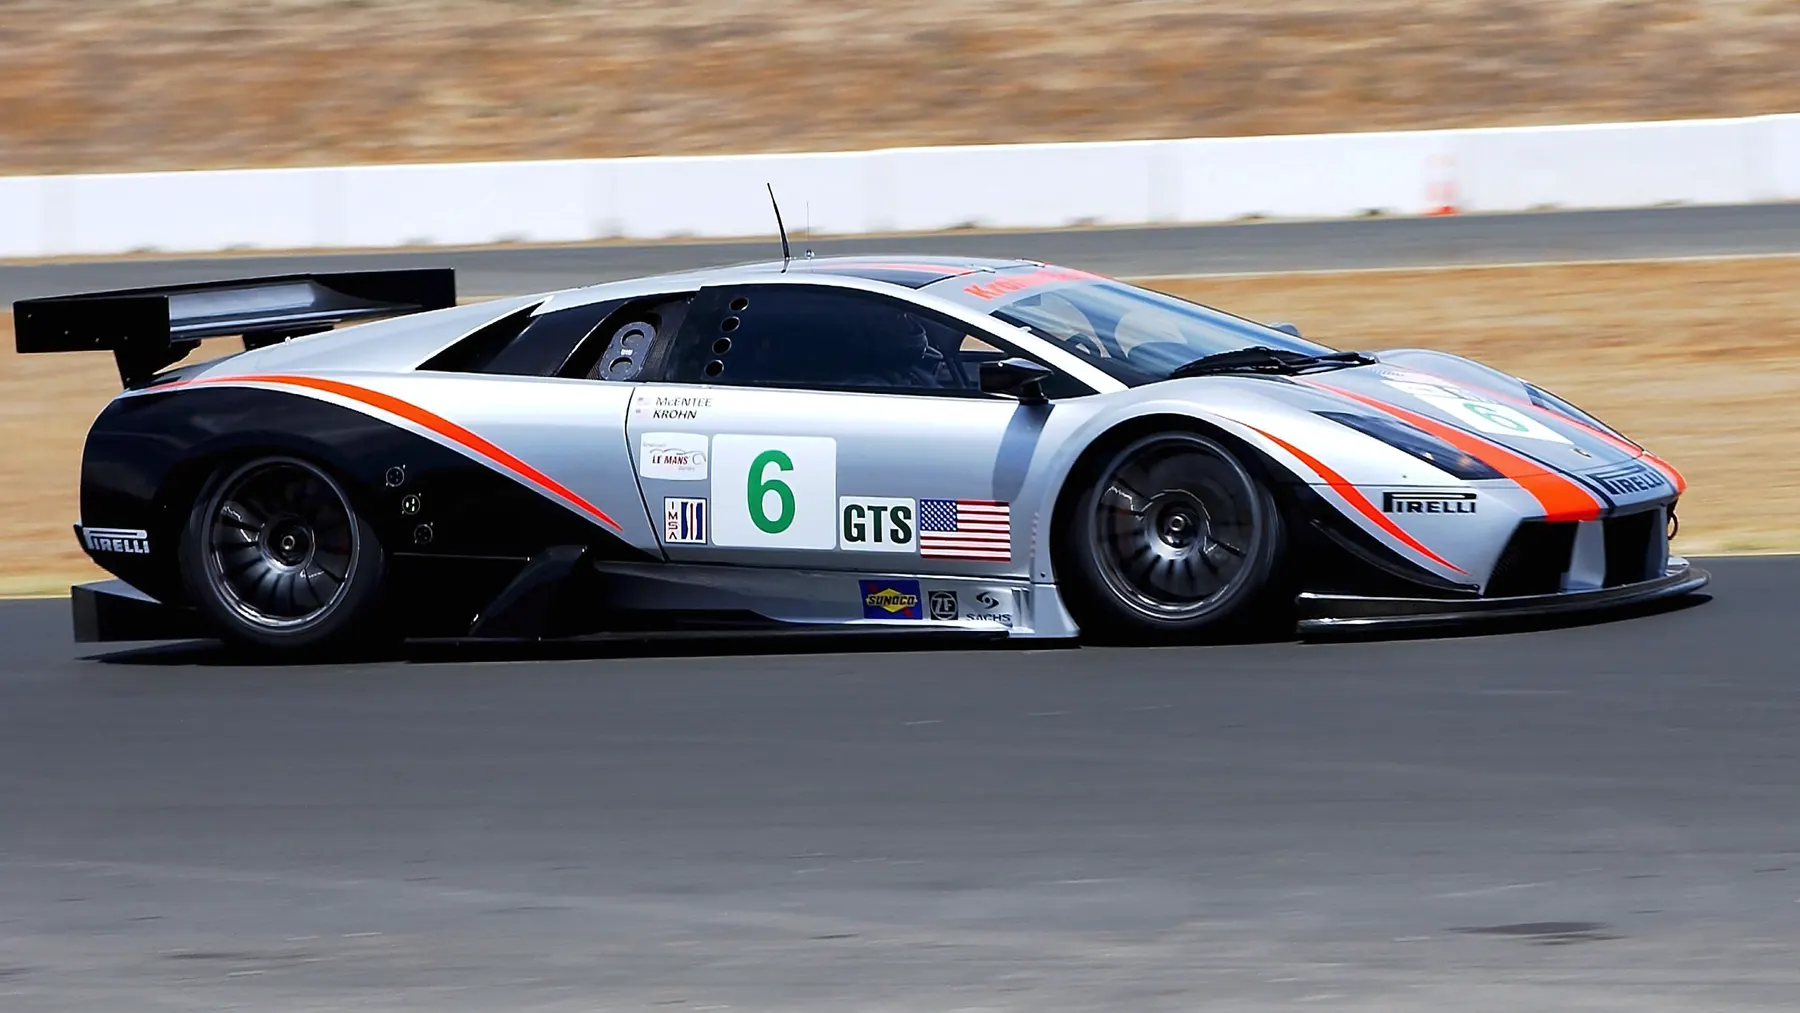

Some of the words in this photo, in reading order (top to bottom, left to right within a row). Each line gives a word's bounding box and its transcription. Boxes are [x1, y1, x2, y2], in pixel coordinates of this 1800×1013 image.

[653, 409, 697, 419] KROHN
[1462, 402, 1529, 432] 6
[664, 455, 689, 465] MANS
[747, 449, 796, 534] 6
[1585, 463, 1664, 495] PIRELLI
[1383, 492, 1476, 513] PIRELLI
[668, 501, 678, 540] IMSA
[843, 504, 912, 544] GTS
[83, 527, 150, 553] PIRELLI
[868, 595, 916, 606] SUNOCO
